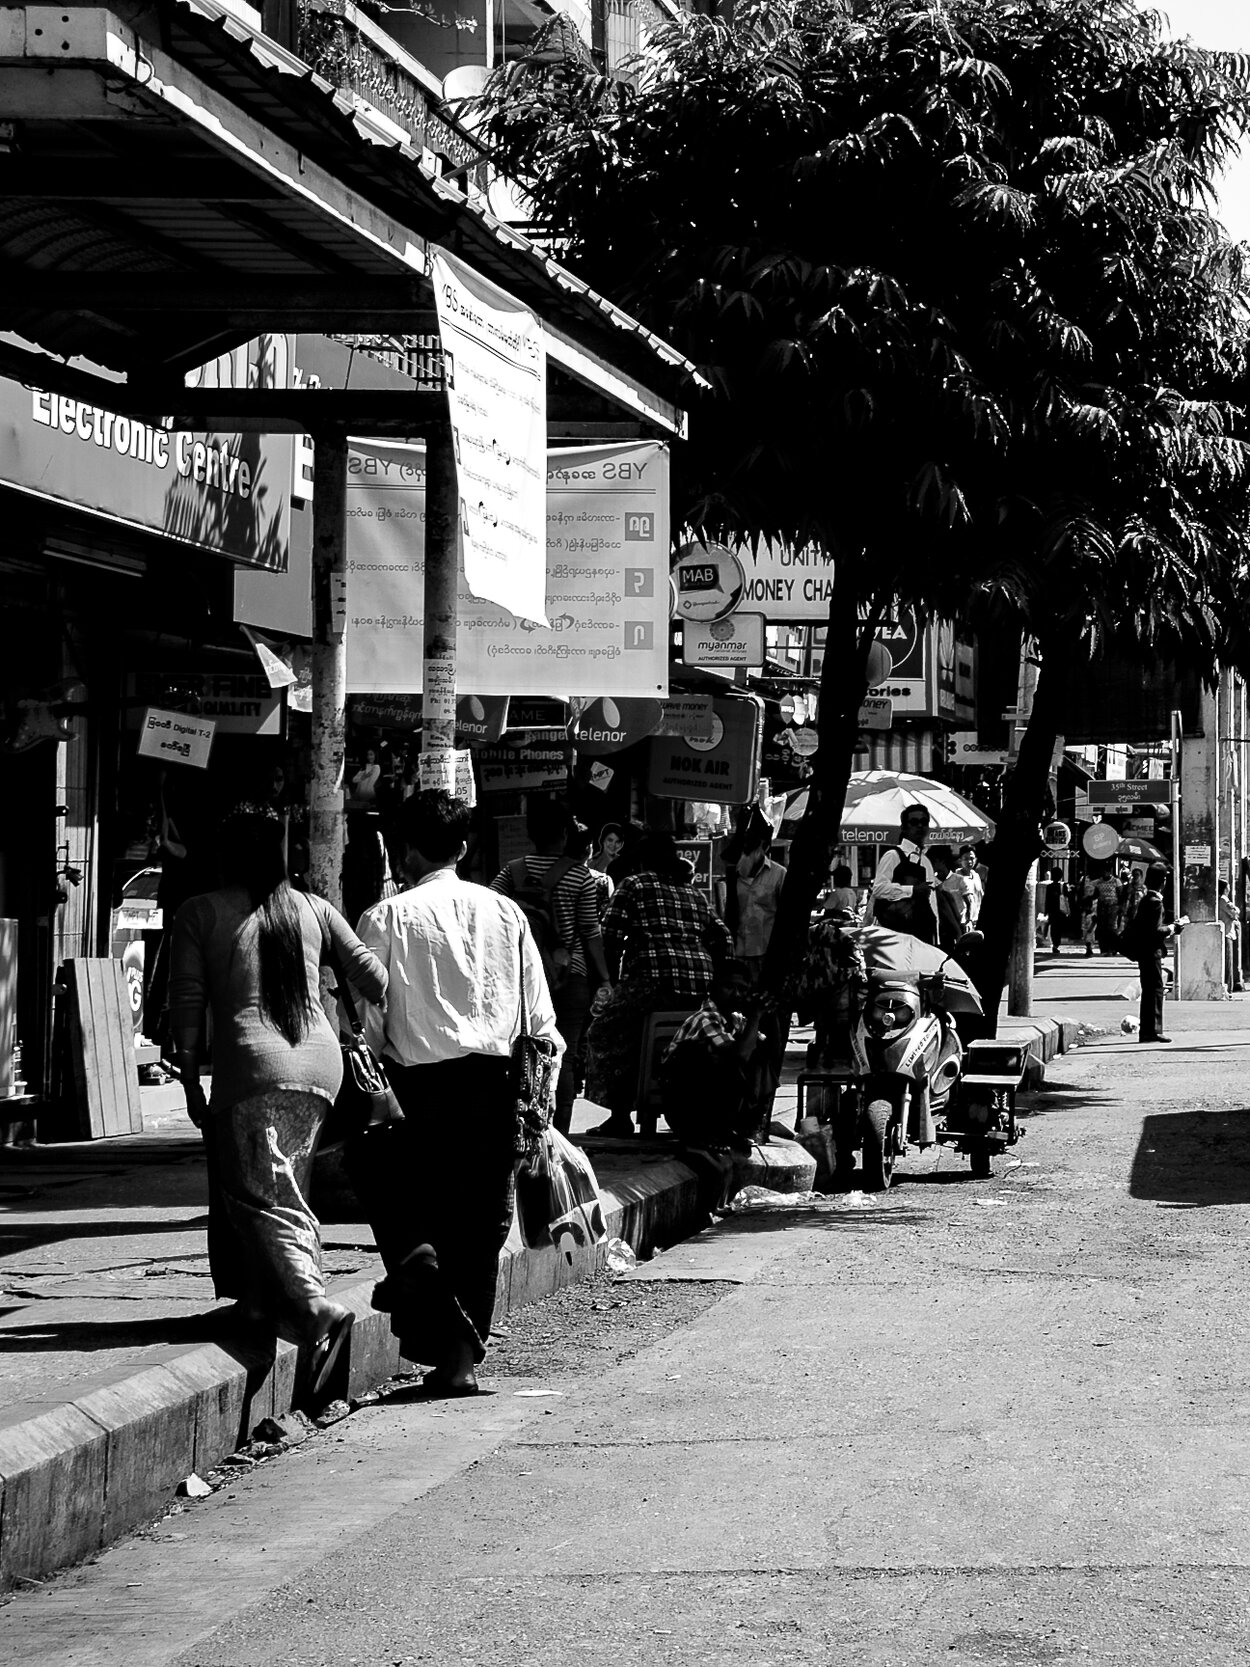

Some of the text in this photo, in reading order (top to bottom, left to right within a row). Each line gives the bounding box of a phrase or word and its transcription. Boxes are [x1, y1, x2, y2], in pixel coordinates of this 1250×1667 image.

[32, 390, 251, 499] Electronic Centre
[682, 568, 714, 583] MAB
[743, 578, 833, 602] MONEY CHA
[697, 641, 747, 652] myanmar
[869, 686, 911, 697] ories
[863, 699, 888, 709] oney
[173, 723, 197, 736] Digital
[198, 729, 211, 739] T-2
[454, 719, 489, 734] elenor
[574, 727, 627, 742] telenor
[519, 749, 564, 760] Phones
[670, 756, 730, 776] NOK AIR
[1110, 782, 1148, 791] 35th Street
[841, 827, 889, 842] telenor
[676, 850, 701, 865] ney
